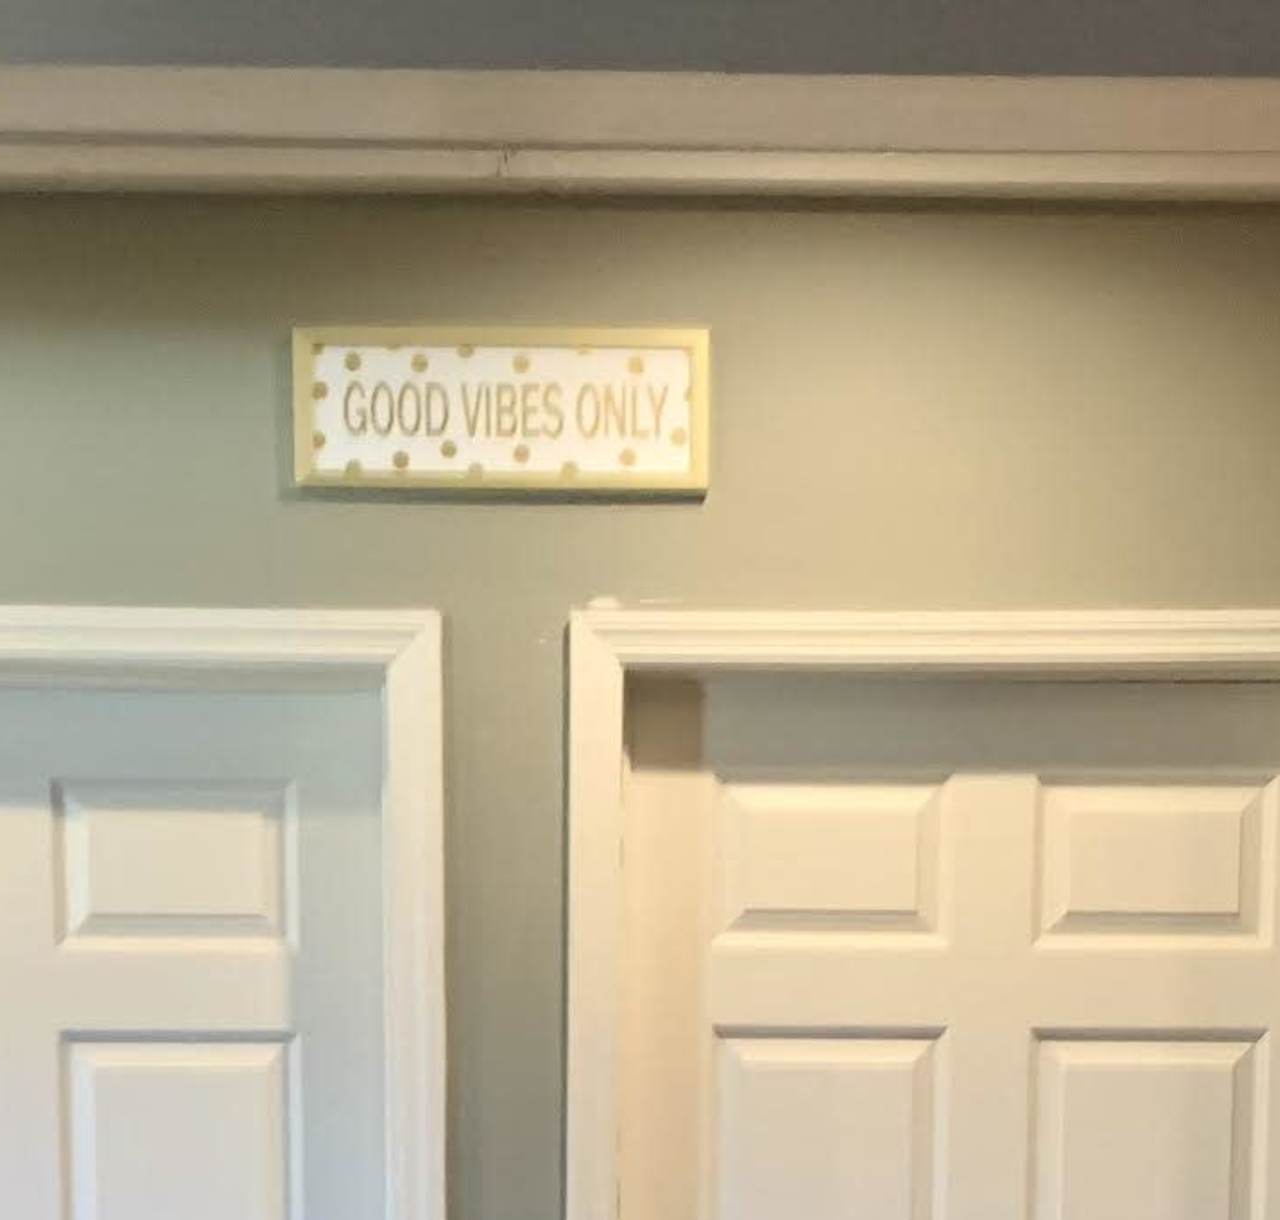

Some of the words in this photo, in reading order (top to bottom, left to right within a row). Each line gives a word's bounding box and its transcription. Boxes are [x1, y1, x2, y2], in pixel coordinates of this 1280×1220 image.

[342, 379, 450, 438] GOOD
[460, 380, 565, 440] VIBES
[575, 381, 670, 440] ONLY
